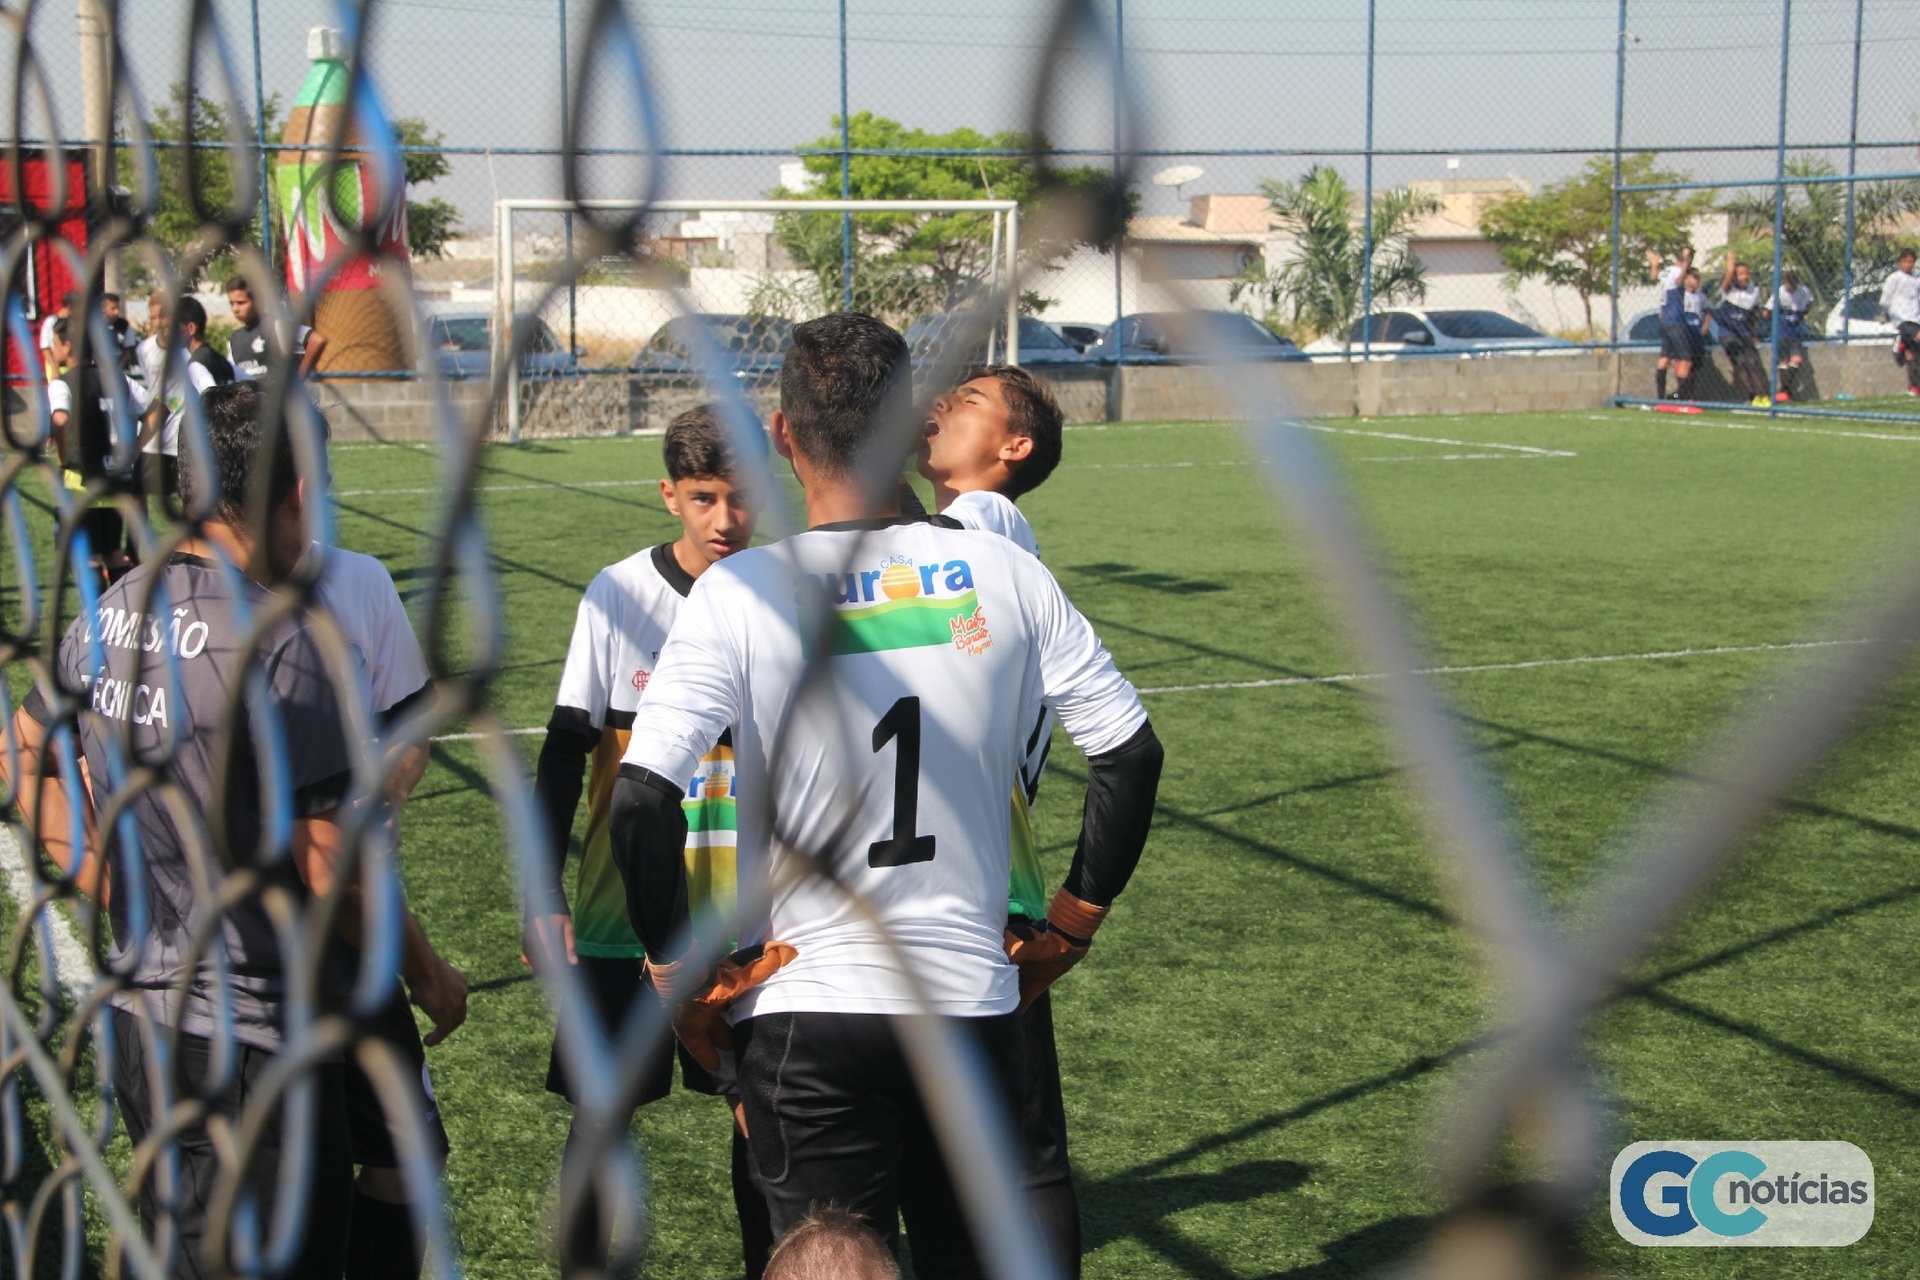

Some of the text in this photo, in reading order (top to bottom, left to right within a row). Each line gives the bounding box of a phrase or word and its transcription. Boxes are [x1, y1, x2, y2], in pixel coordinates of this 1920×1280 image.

[880, 555, 914, 569] CASA
[81, 666, 168, 728] TÉCNICA
[868, 696, 936, 868] 1
